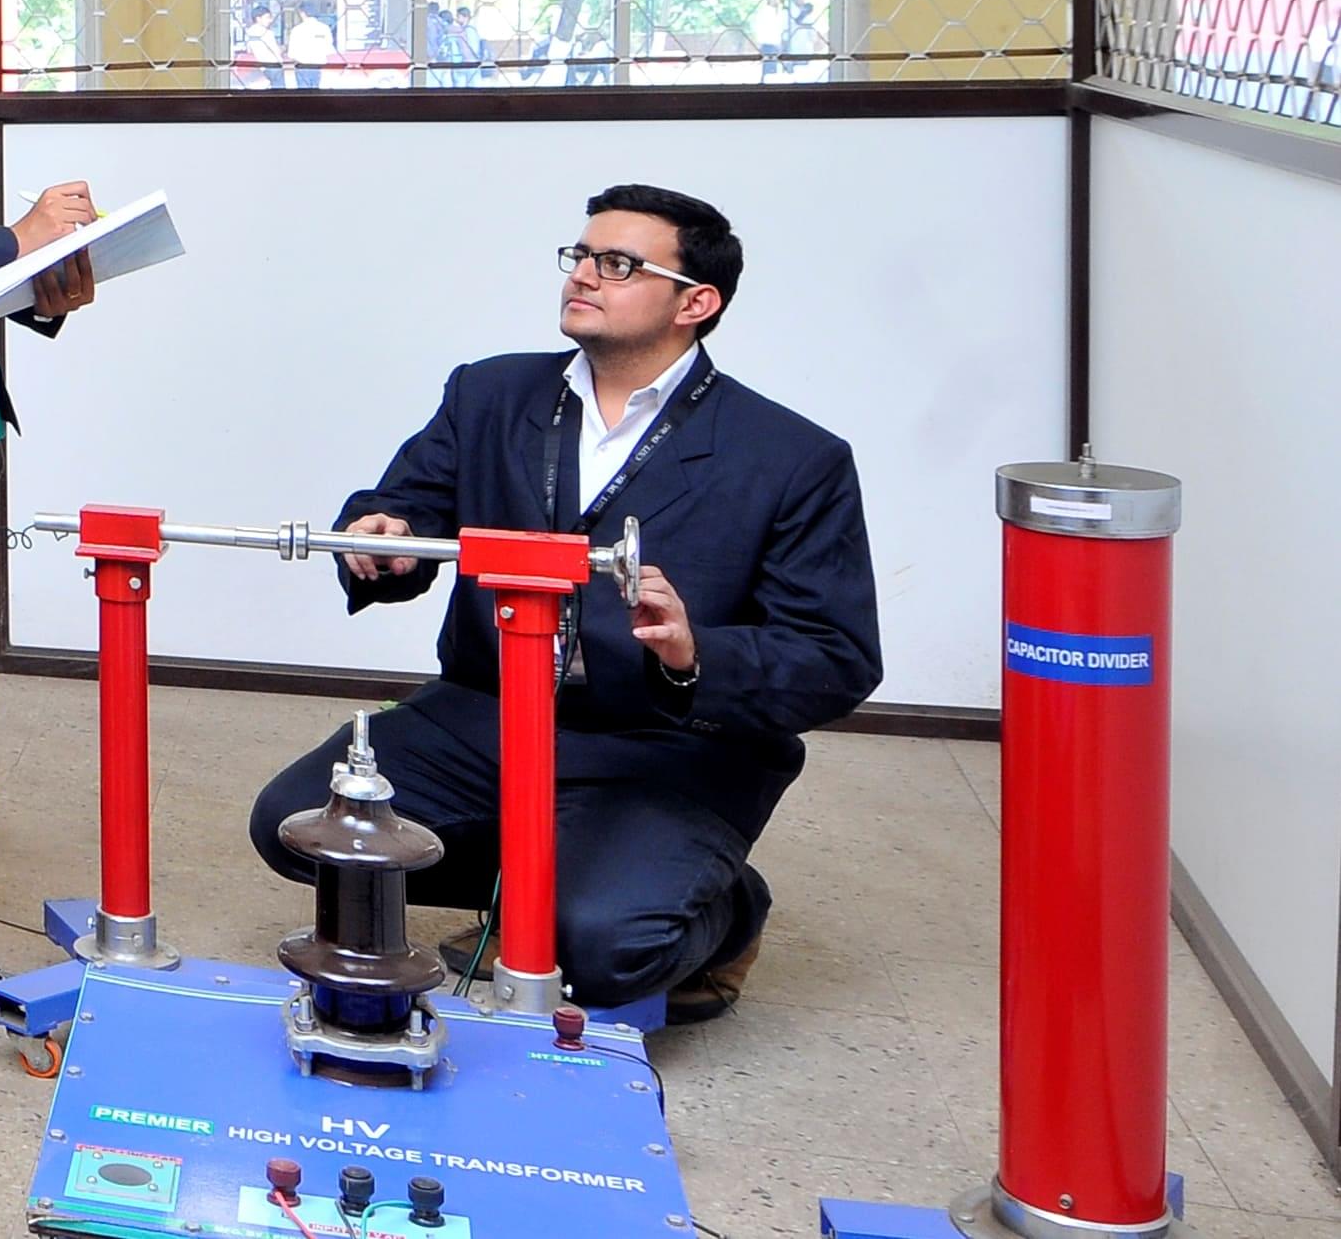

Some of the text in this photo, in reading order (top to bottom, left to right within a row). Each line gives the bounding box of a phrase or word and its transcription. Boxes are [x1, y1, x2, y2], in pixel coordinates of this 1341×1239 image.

[1007, 637, 1149, 669] CAPACITOR DIVIDER
[553, 1054, 602, 1066] EARTH
[94, 1106, 212, 1134] PREMIER
[321, 1115, 391, 1139] HV
[228, 1125, 647, 1193] HIGH VOLTAGE TRANSFORMER
